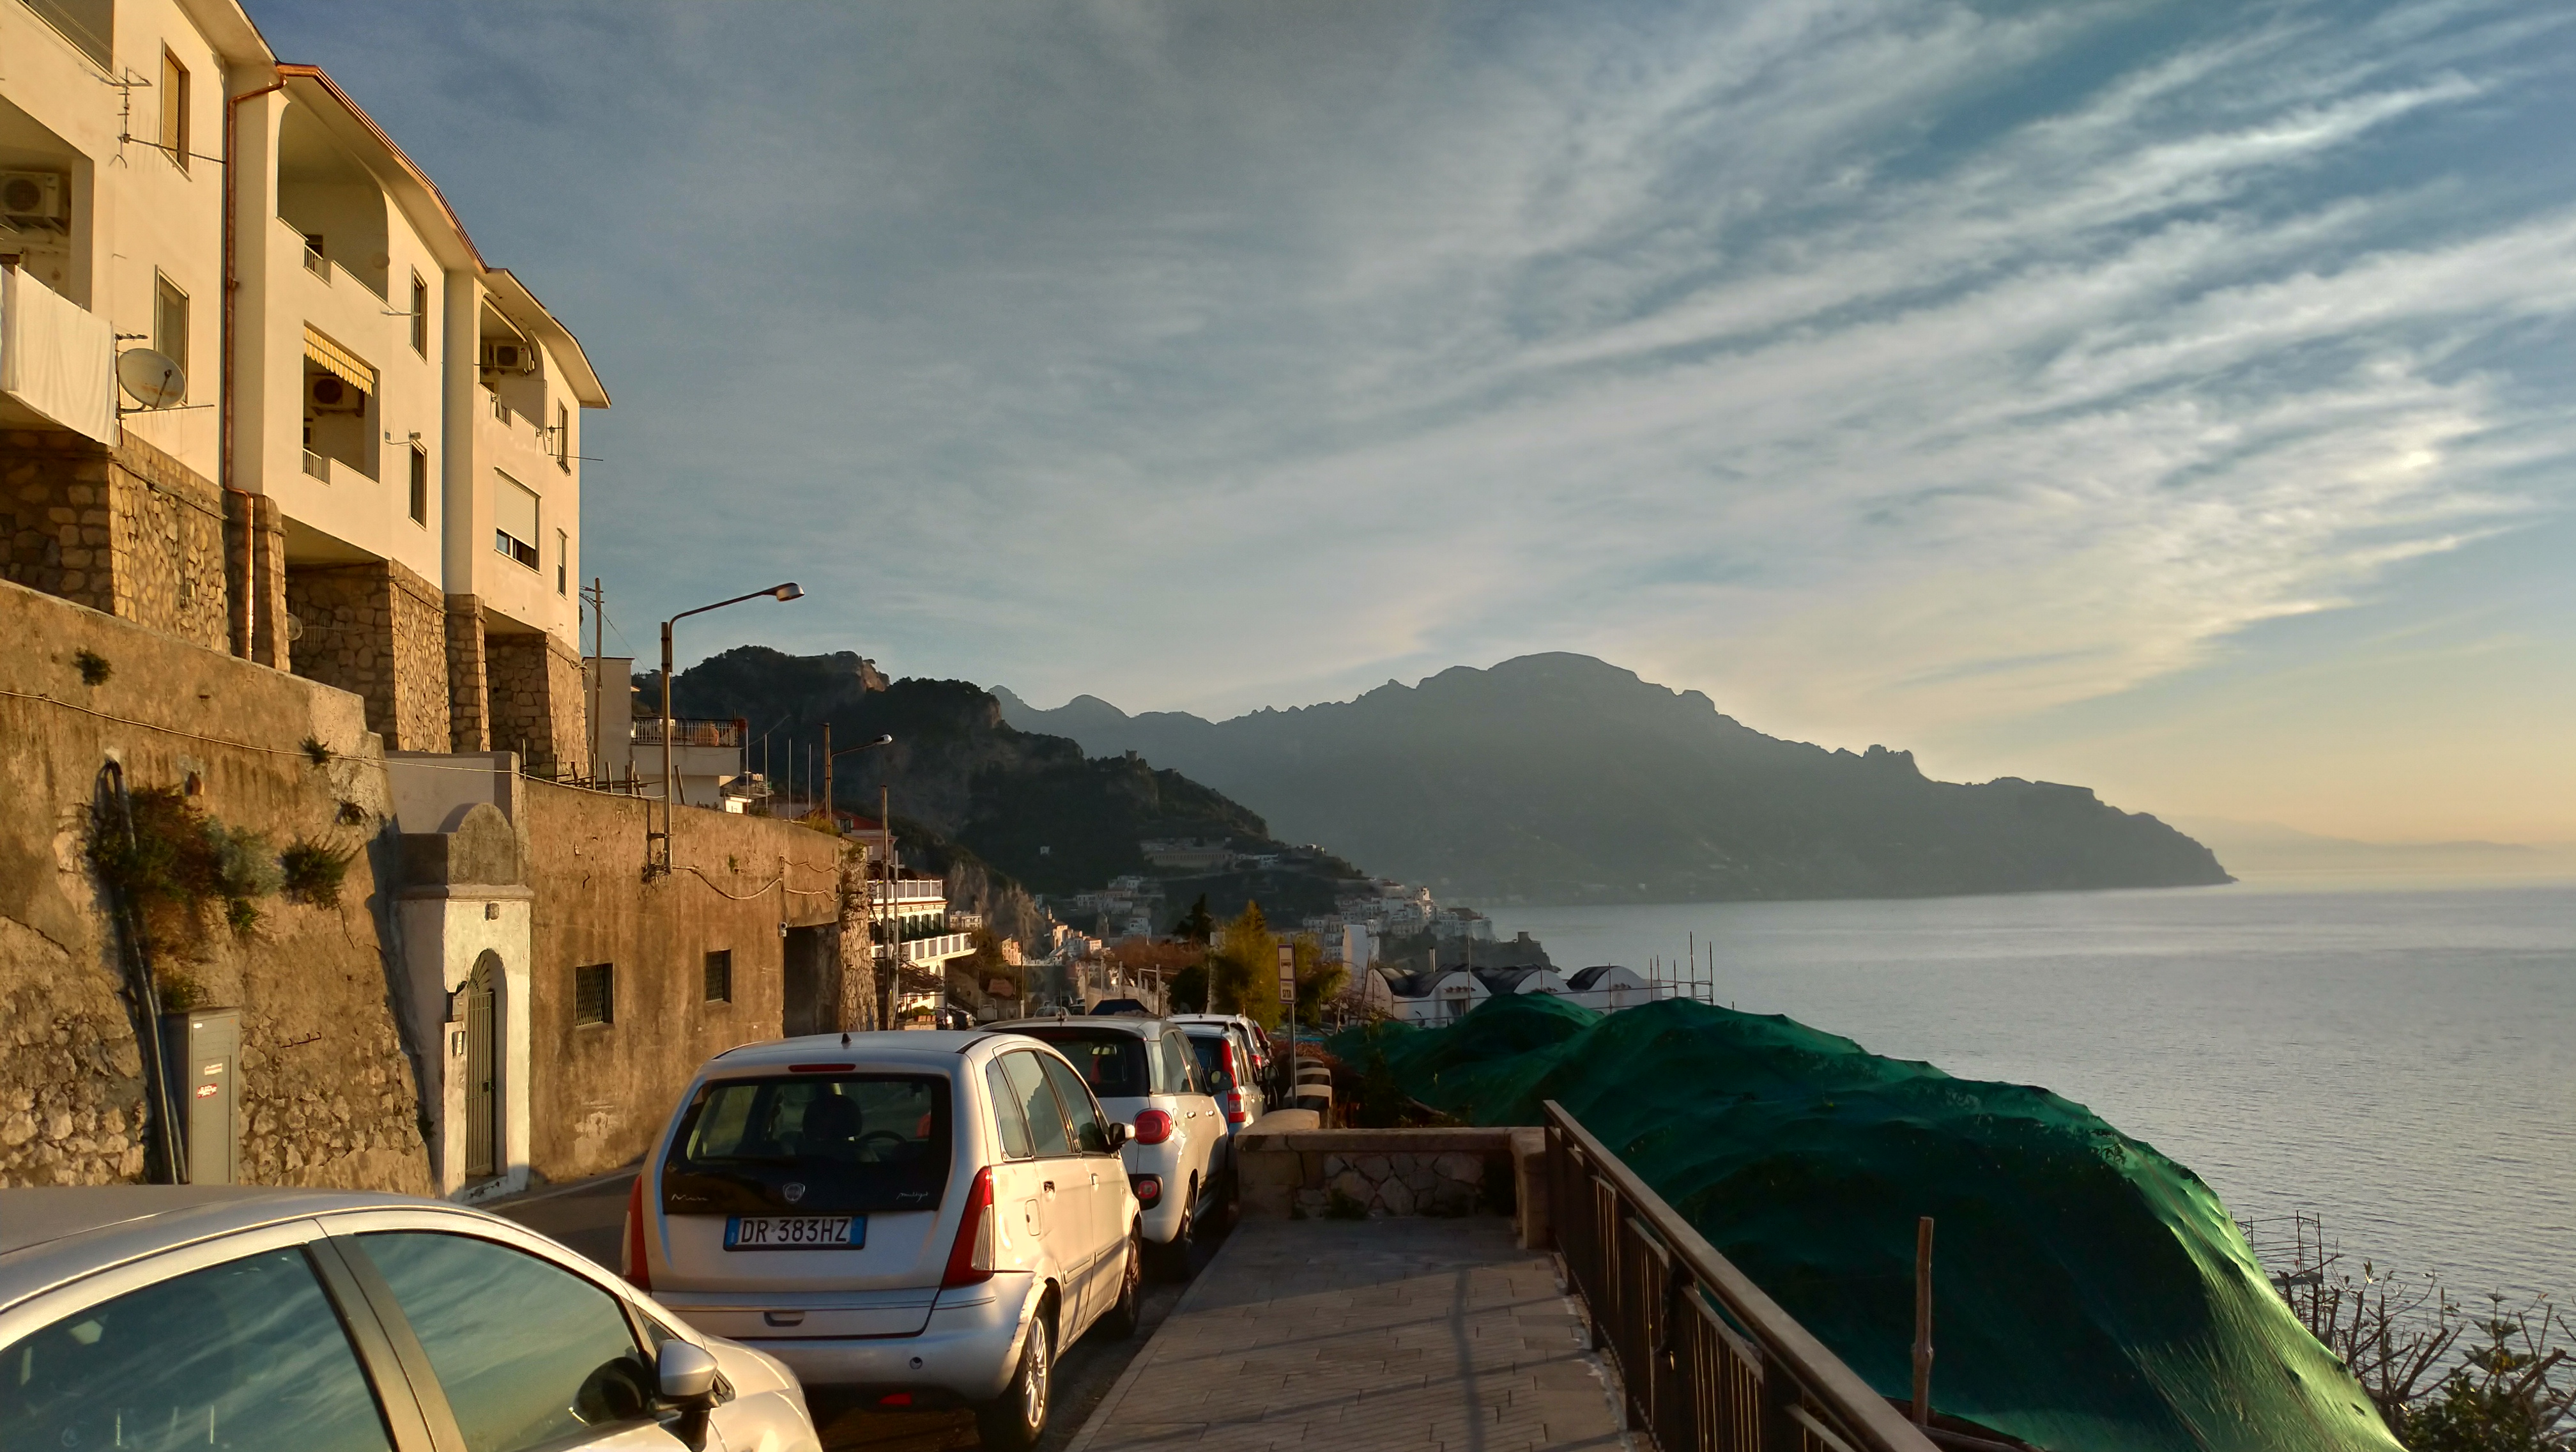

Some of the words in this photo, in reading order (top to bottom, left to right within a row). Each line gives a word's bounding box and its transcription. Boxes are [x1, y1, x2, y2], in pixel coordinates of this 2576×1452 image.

[1282, 989, 1292, 998] SITA
[741, 1219, 769, 1243] DR
[778, 1219, 849, 1242] 383HZ
